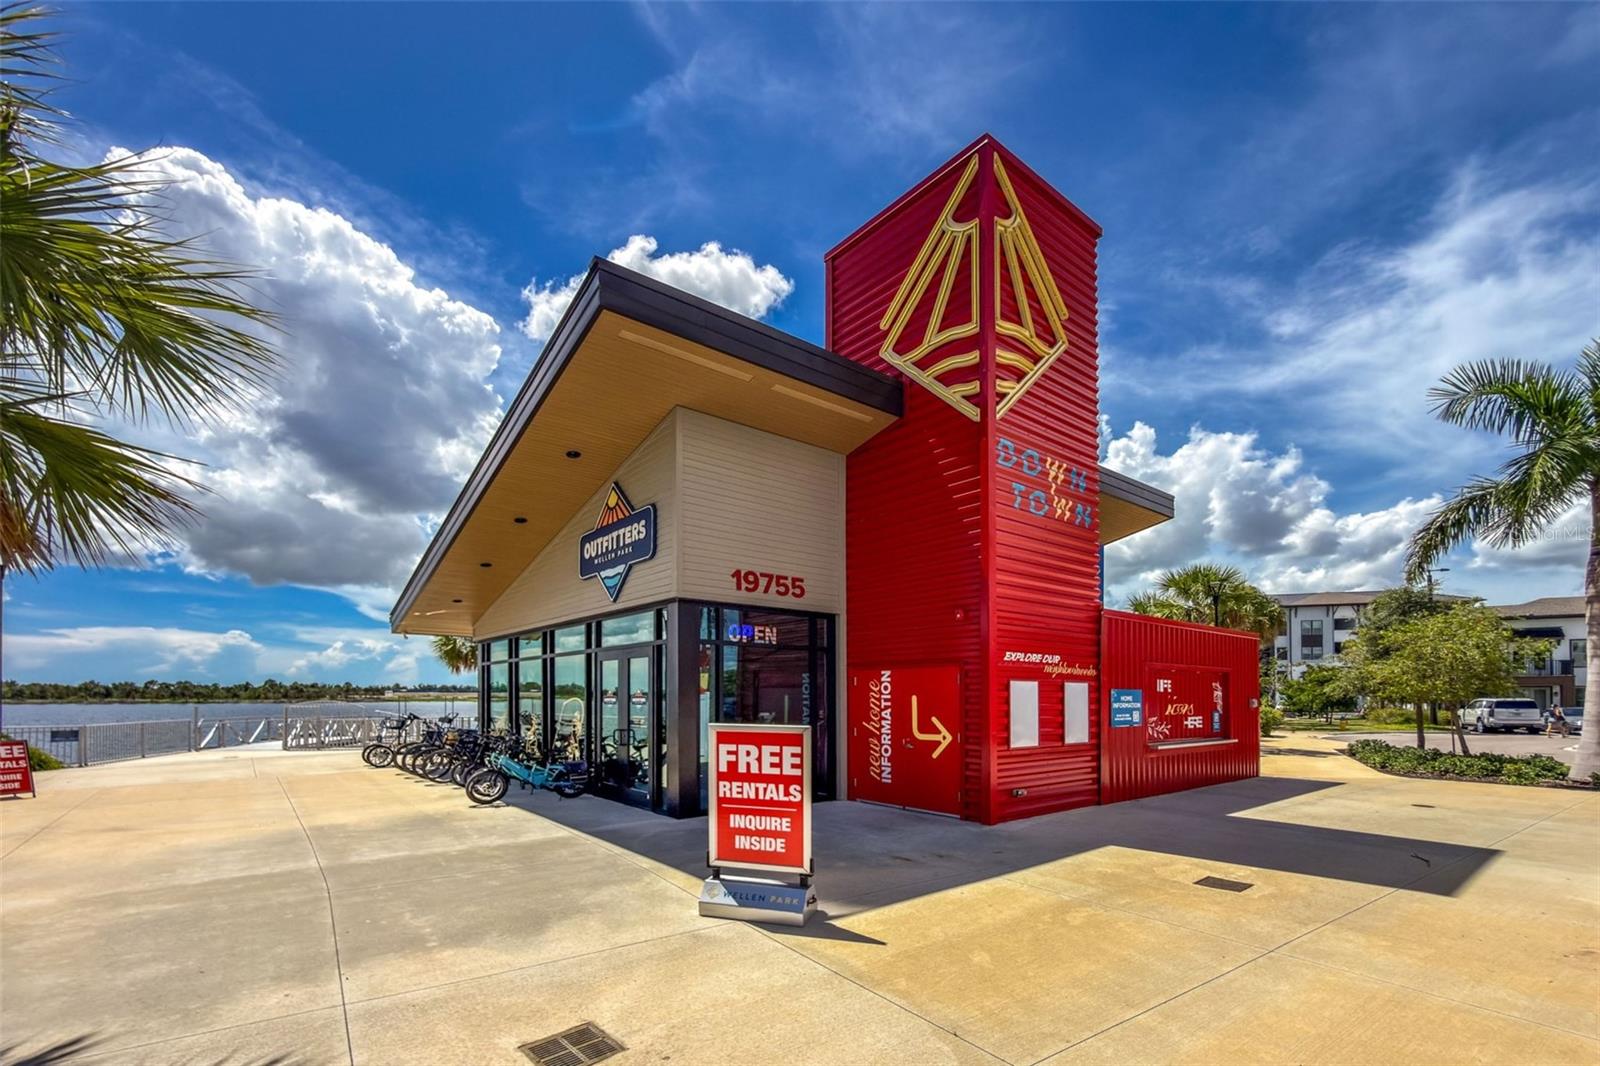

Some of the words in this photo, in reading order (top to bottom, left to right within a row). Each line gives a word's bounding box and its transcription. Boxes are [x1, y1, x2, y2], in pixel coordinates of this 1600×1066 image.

[996, 437, 1087, 493] DOWN
[1011, 482, 1092, 528] TOWN
[584, 519, 647, 559] OUTFITTERS
[617, 545, 633, 557] PARK
[730, 568, 806, 599] 19755
[728, 623, 777, 645] OPEN
[1003, 651, 1043, 663] EXPLORE
[1042, 654, 1061, 664] OUR
[862, 678, 881, 735] home
[880, 670, 892, 783] INFORMATION
[0, 745, 25, 758] EE
[718, 743, 802, 776] FREE
[868, 737, 881, 780] new
[0, 760, 27, 769] TALS
[0, 782, 21, 790] SIDE
[718, 781, 802, 802] RENTALS
[729, 813, 791, 832] INQUIRE
[735, 834, 786, 853] INSIDE
[723, 889, 766, 902] WELLEN
[769, 894, 800, 906] PARK
